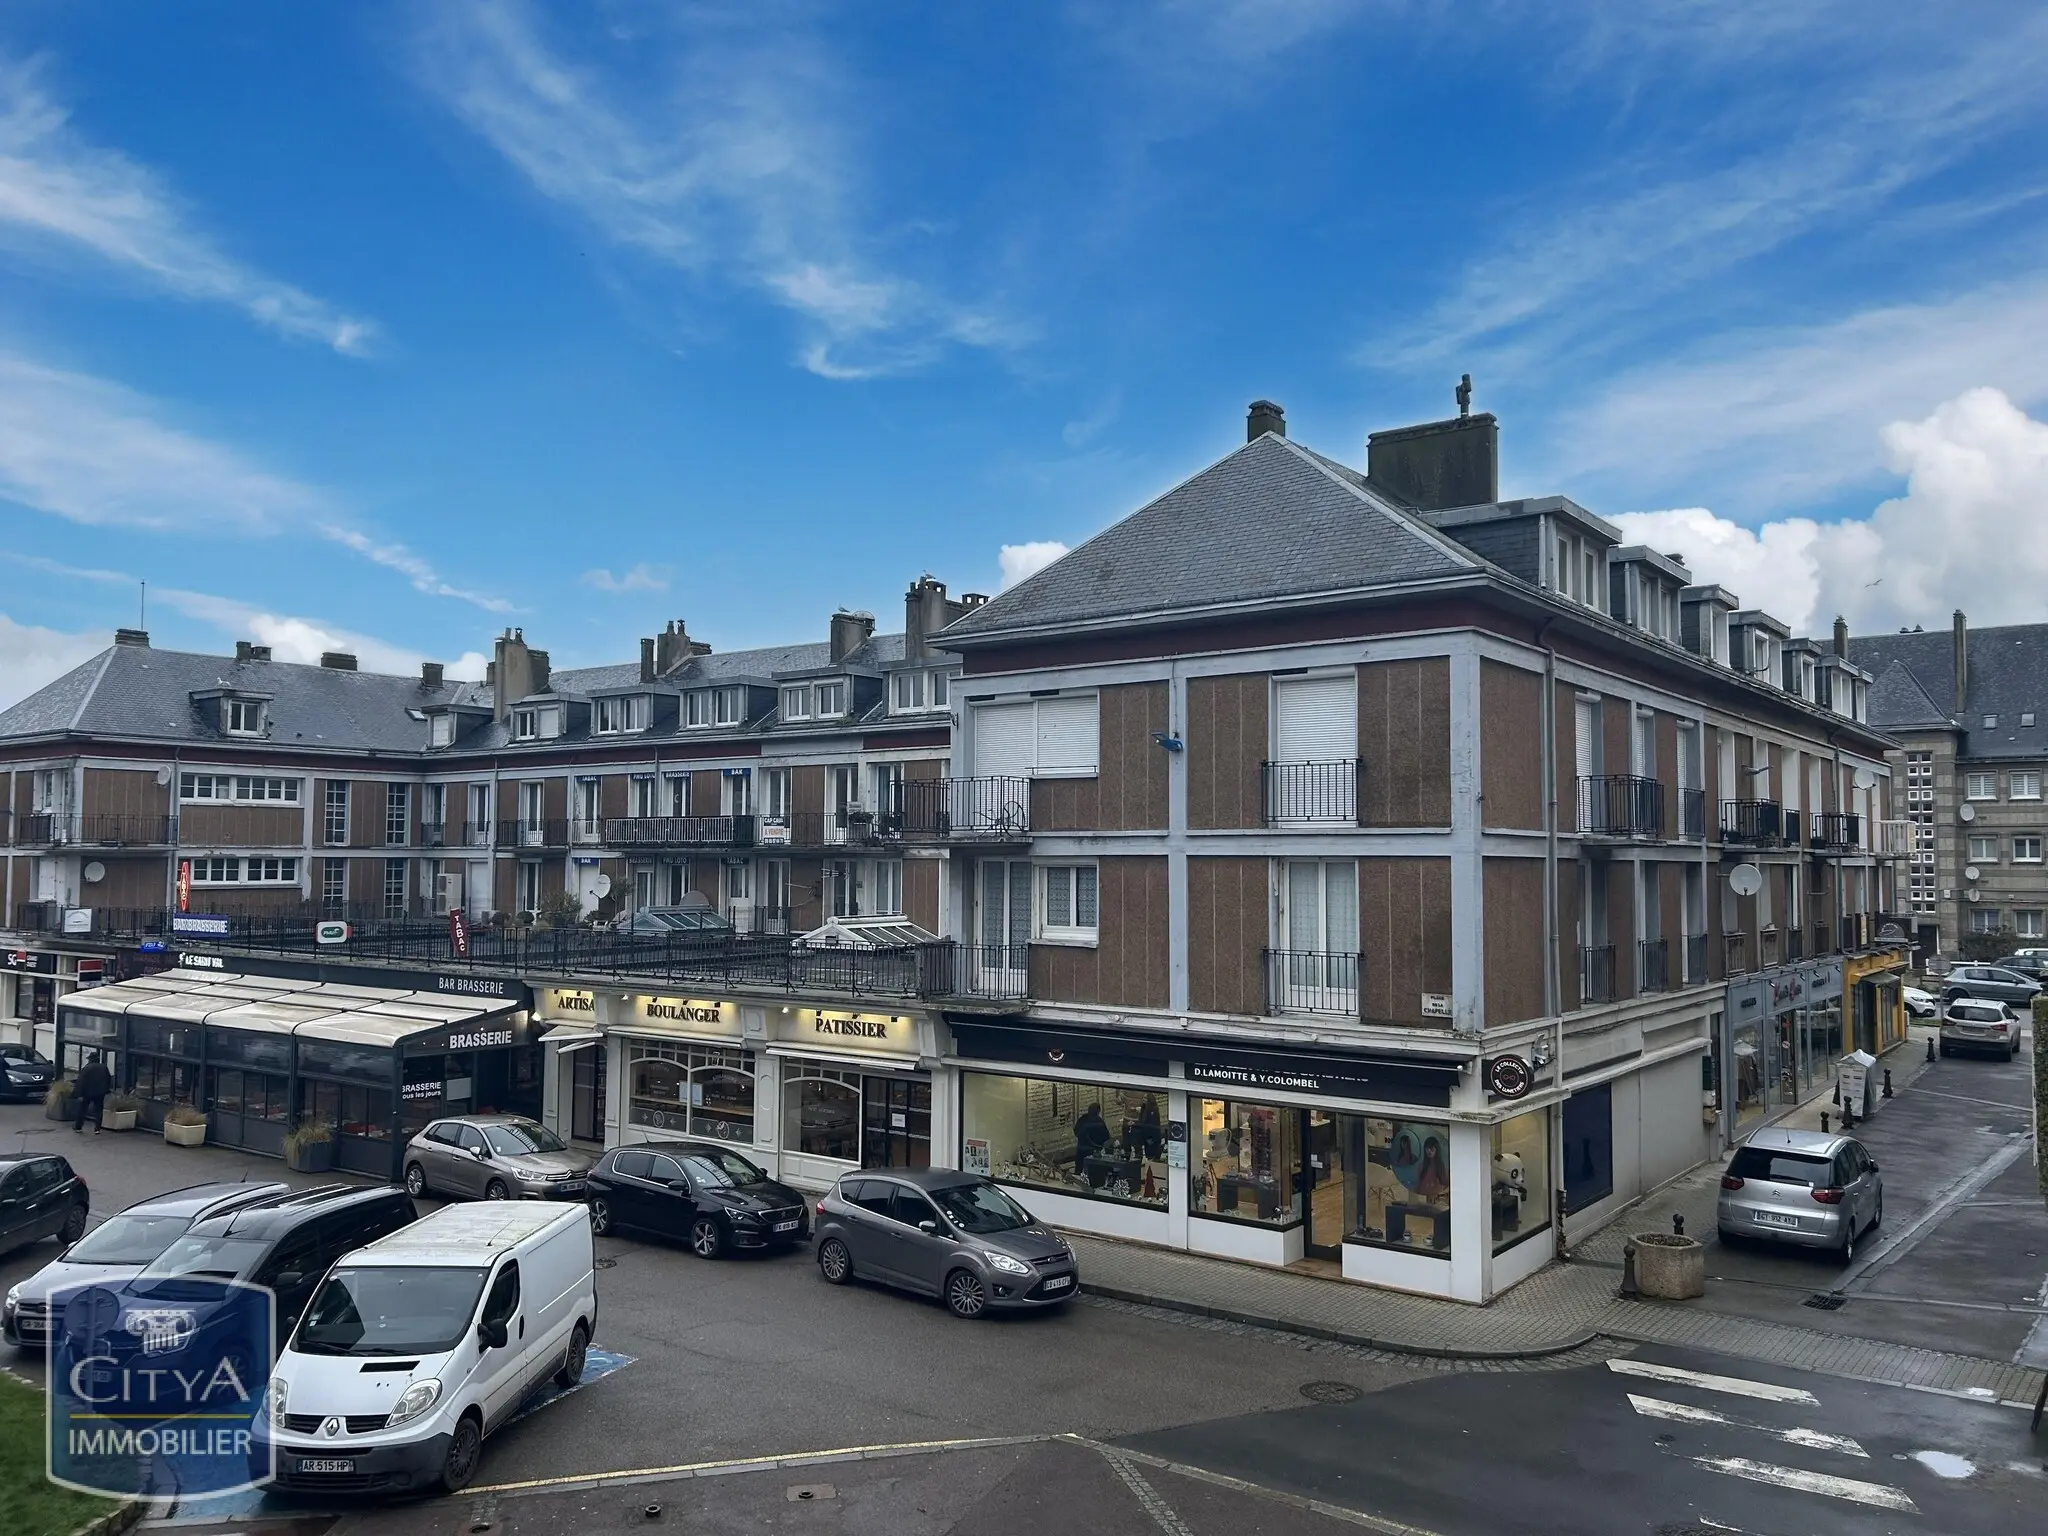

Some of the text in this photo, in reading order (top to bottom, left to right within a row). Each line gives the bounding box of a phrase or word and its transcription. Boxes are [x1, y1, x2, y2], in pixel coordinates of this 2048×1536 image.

[454, 915, 466, 951] TABAC
[7, 953, 17, 966] SG
[438, 977, 504, 994] BAR BRASSERIE
[557, 997, 595, 1011] ARTISA
[646, 1002, 720, 1023] BOULANGER
[815, 1017, 887, 1039] PATISSIER
[449, 1030, 512, 1049] BRASSERIE
[1500, 1061, 1524, 1075] COLLECTIF
[1194, 1067, 1248, 1082] D.LAMOITTE
[1250, 1073, 1257, 1082] &
[1259, 1074, 1319, 1089] Y.COLOMBEL
[424, 1090, 442, 1098] jours
